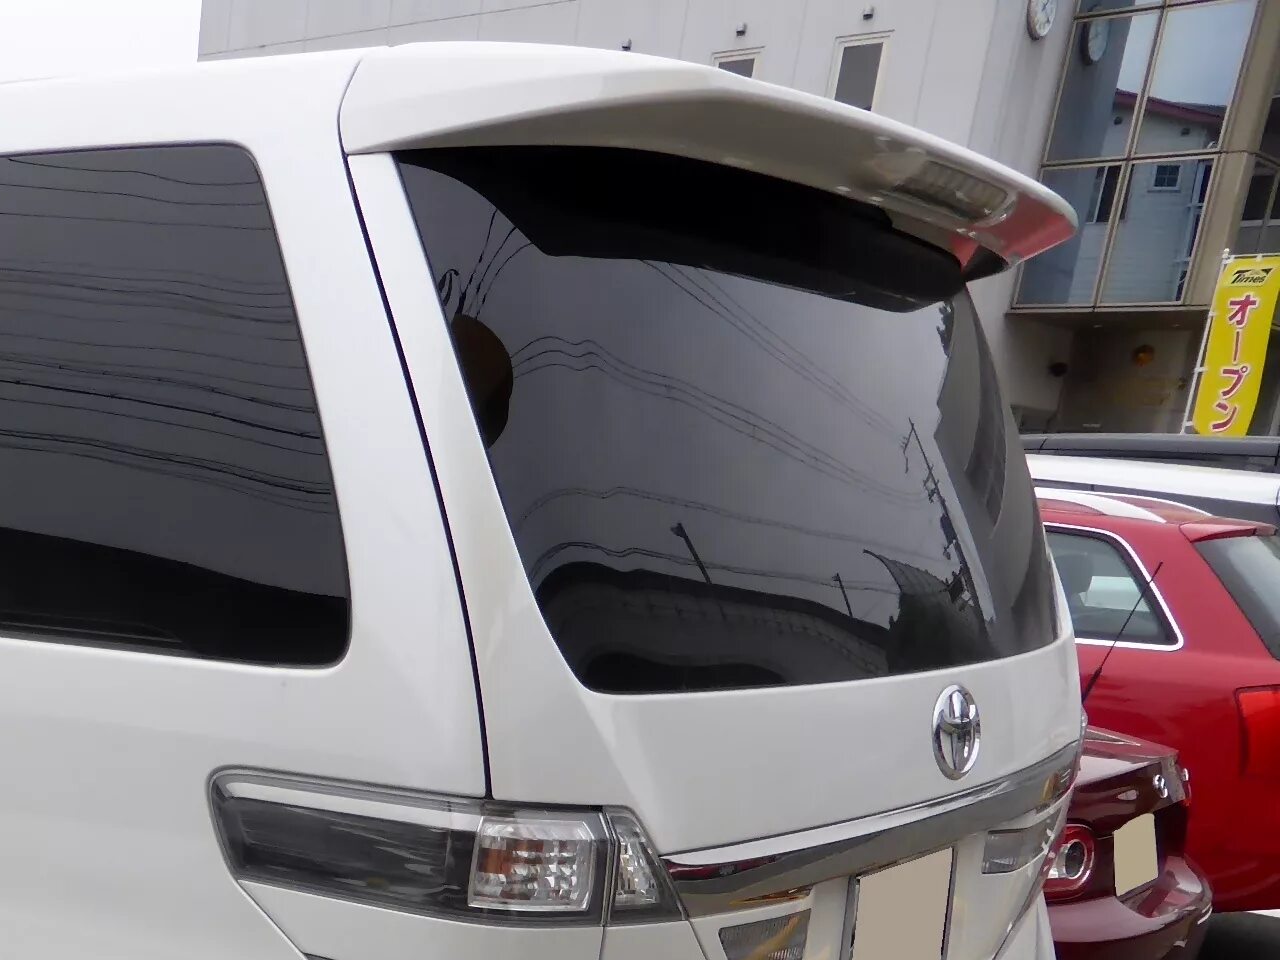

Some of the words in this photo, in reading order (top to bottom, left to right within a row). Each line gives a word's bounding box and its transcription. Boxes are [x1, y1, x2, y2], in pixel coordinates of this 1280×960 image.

[1231, 268, 1273, 284] Times
[1211, 294, 1258, 431] オープン
